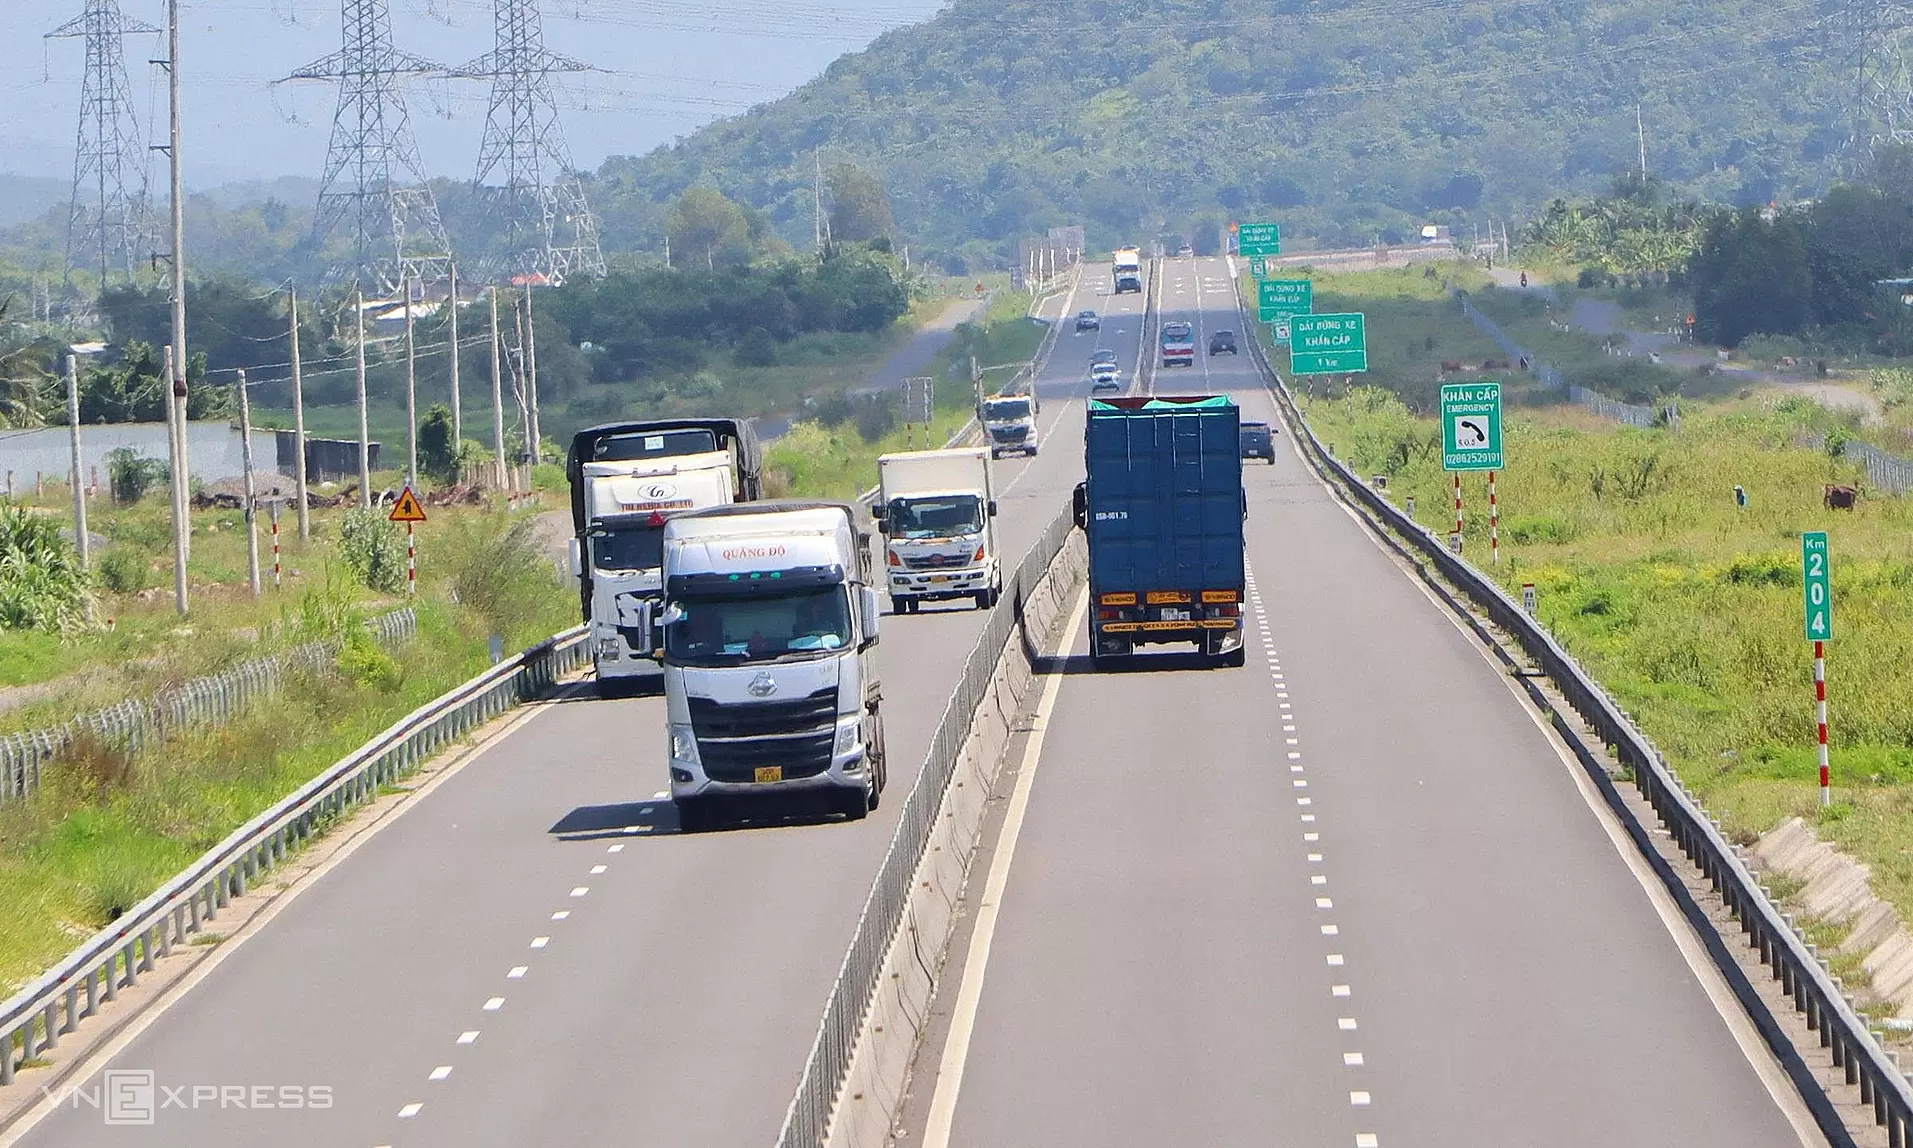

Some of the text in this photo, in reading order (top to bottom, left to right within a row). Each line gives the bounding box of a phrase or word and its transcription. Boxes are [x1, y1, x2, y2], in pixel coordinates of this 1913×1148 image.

[1345, 320, 1357, 330] XE
[1446, 403, 1495, 413] EMERGENCY
[1806, 539, 1825, 549] Km
[1809, 553, 1825, 634] 204
